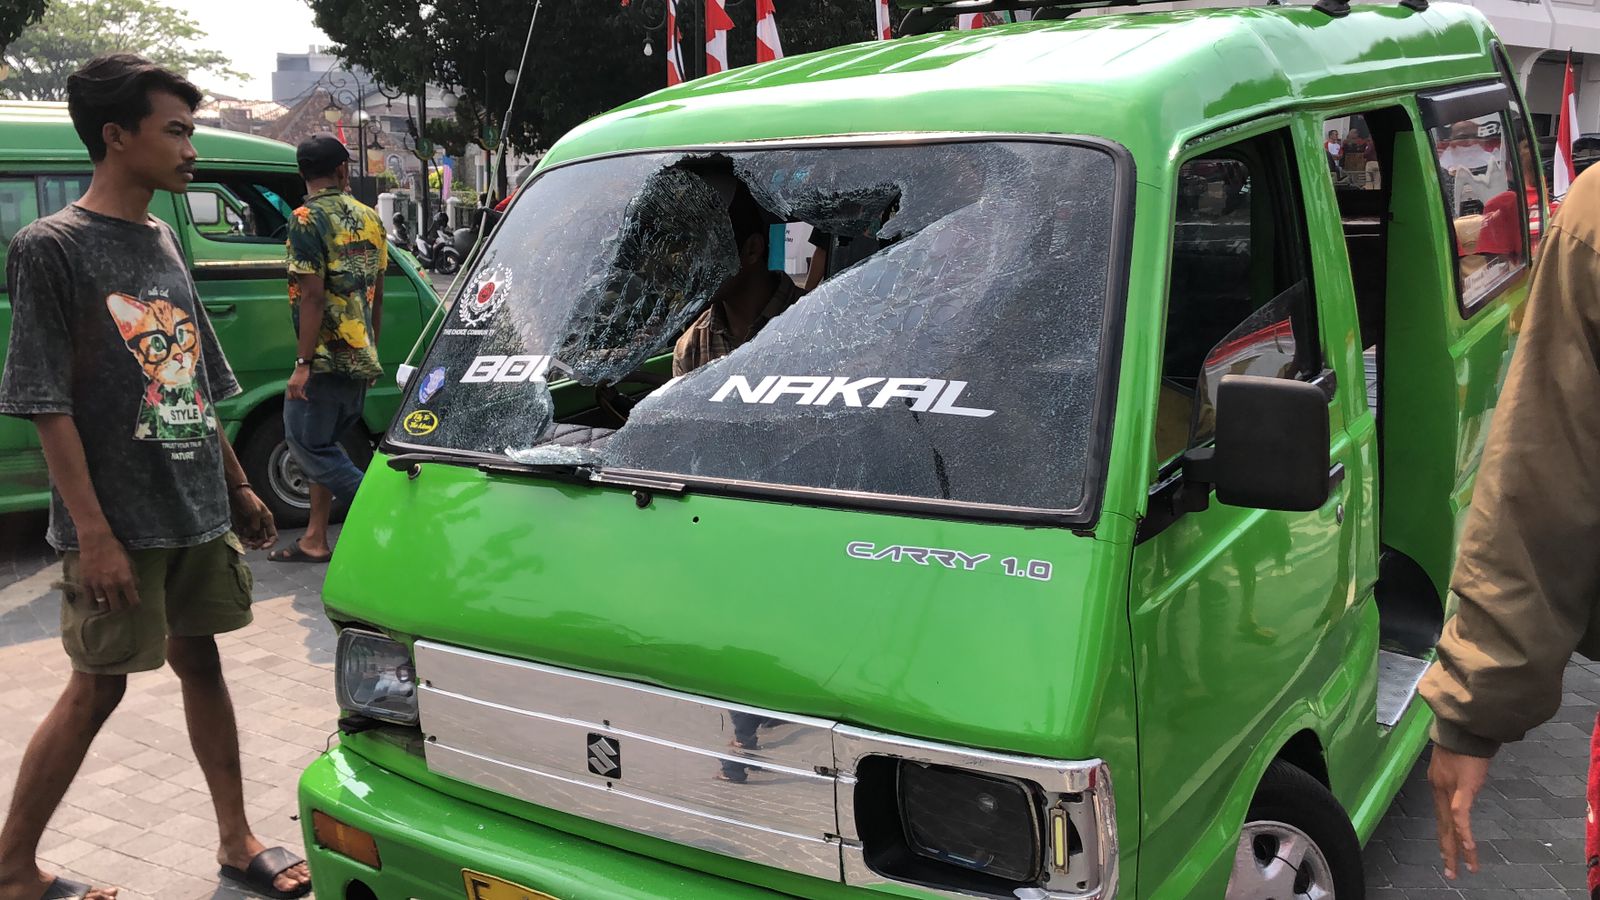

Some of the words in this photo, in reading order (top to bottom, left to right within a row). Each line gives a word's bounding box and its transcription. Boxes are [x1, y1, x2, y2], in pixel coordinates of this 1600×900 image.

[708, 375, 995, 418] NAKAL
[170, 409, 199, 421] STYLE
[171, 452, 194, 461] NATURE
[846, 541, 991, 570] CARRY
[1001, 557, 1052, 581] 1.0
